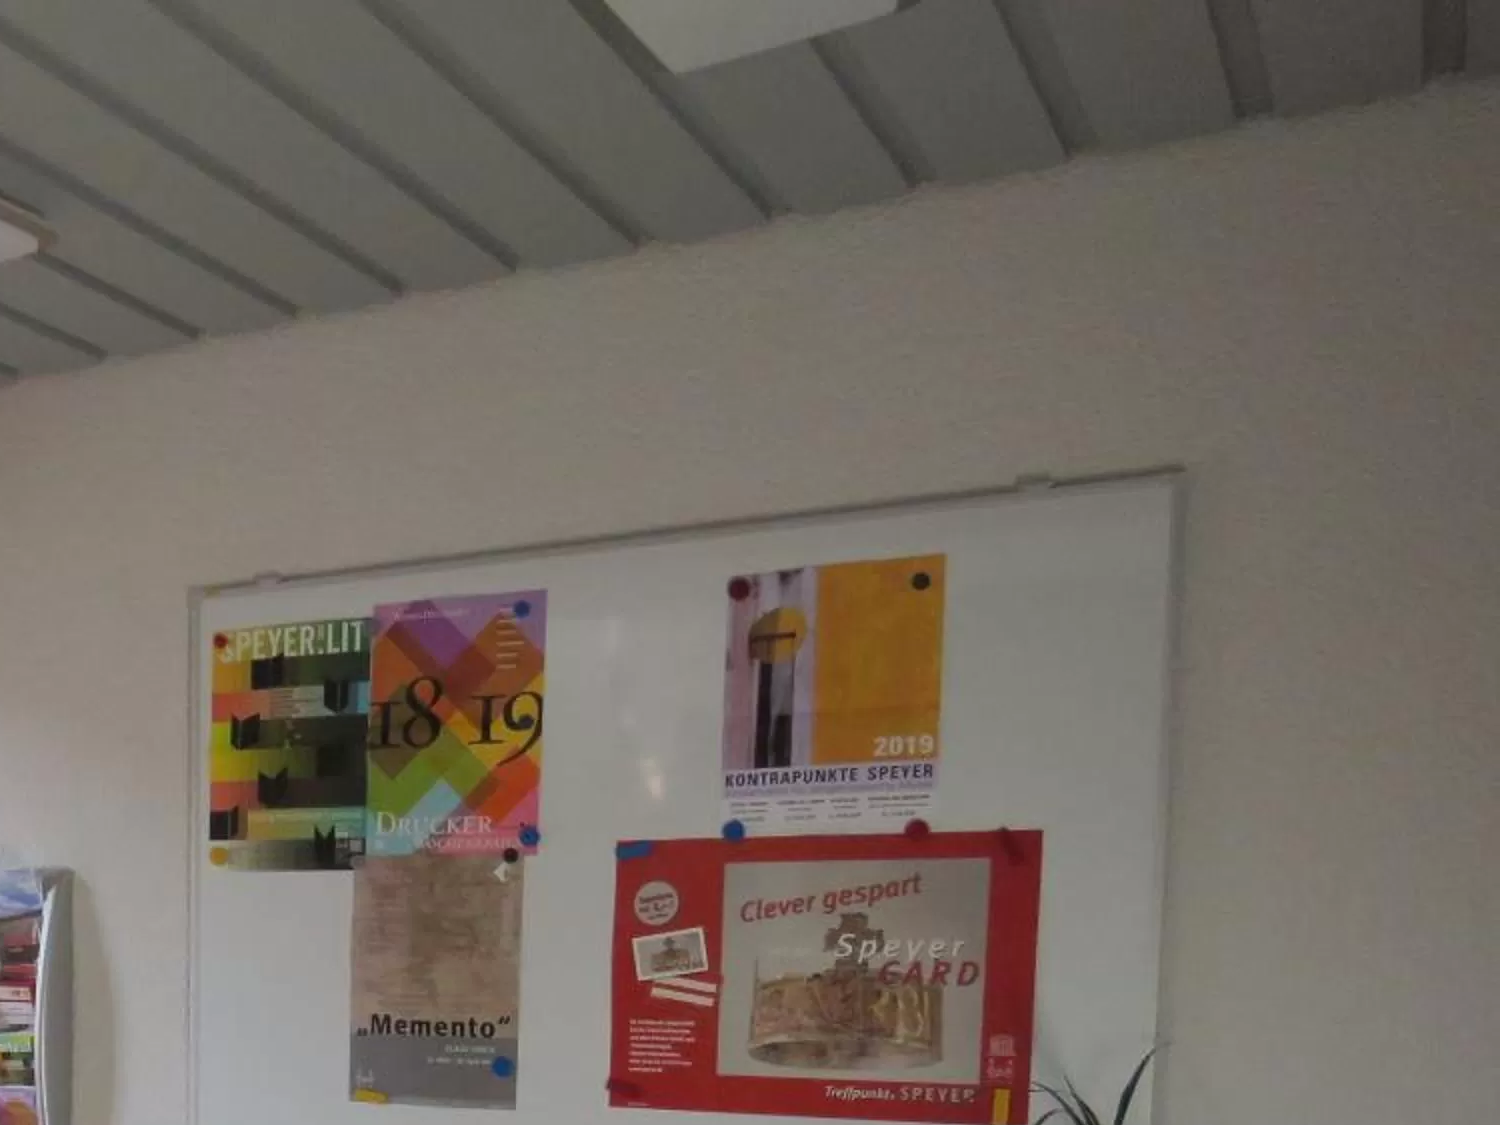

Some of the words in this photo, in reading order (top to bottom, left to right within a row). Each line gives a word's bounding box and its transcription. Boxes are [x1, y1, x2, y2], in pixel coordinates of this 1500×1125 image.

[872, 734, 934, 757] 2019
[724, 766, 859, 788] KONTRAPUNKTE
[867, 762, 933, 781] SPEYER
[375, 811, 493, 836] DRUCKER
[739, 894, 817, 923] Clever
[821, 871, 923, 915] gespart
[833, 933, 965, 965] Speyer
[877, 958, 979, 987] CARD
